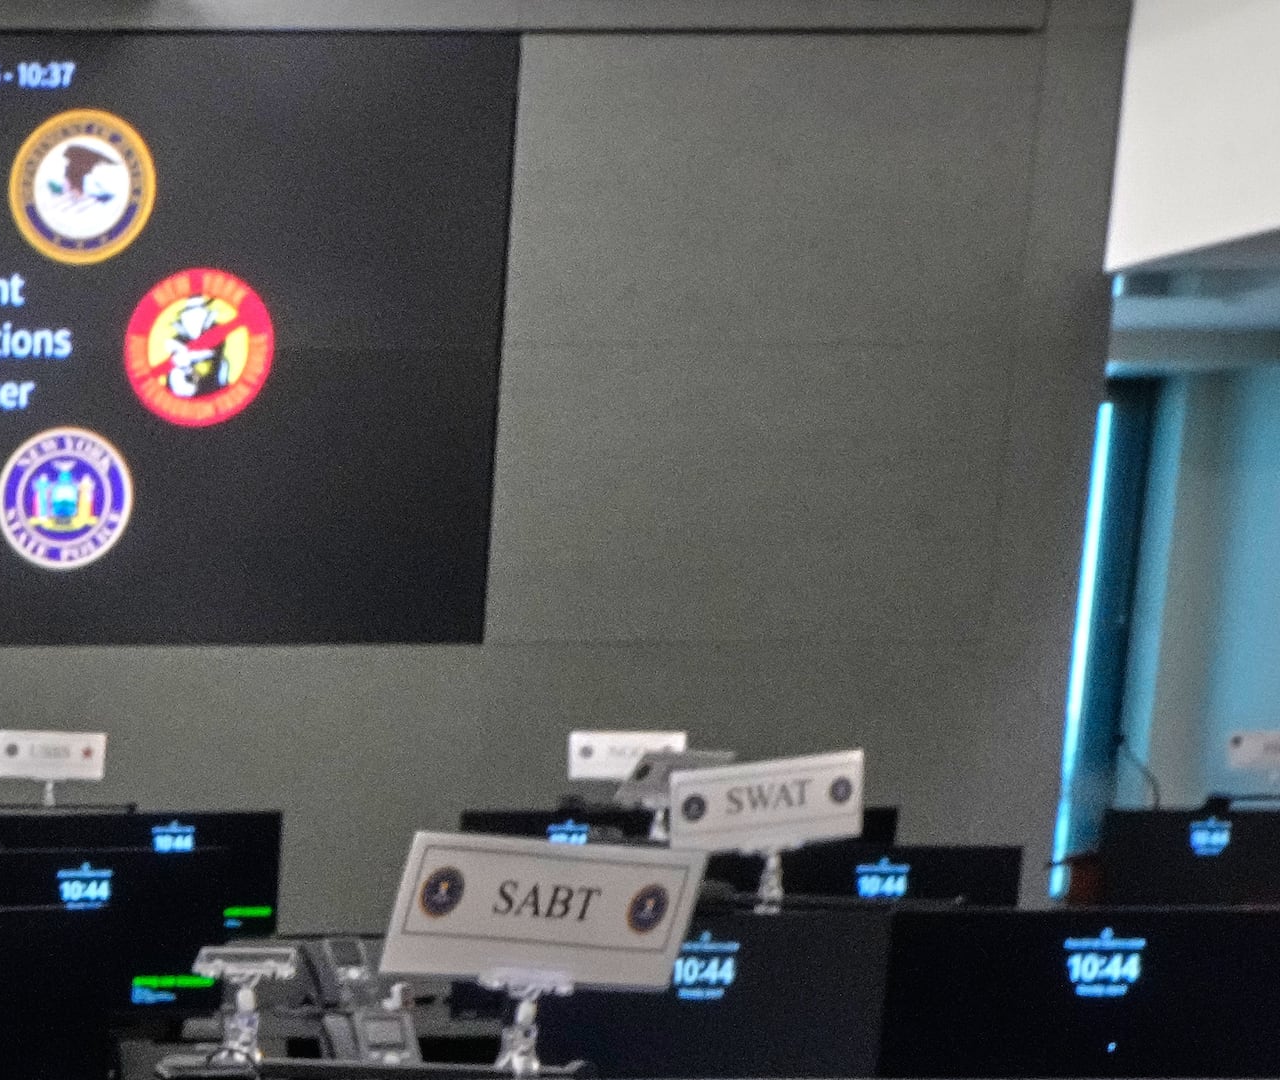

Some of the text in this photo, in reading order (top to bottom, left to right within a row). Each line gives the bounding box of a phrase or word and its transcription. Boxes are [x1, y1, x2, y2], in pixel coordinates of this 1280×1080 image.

[17, 62, 76, 87] 10:37
[724, 778, 812, 816] SWAT
[59, 879, 111, 902] 10:44
[492, 880, 602, 923] SABT
[673, 956, 735, 986] 10:44
[1067, 952, 1141, 983] 10:44
